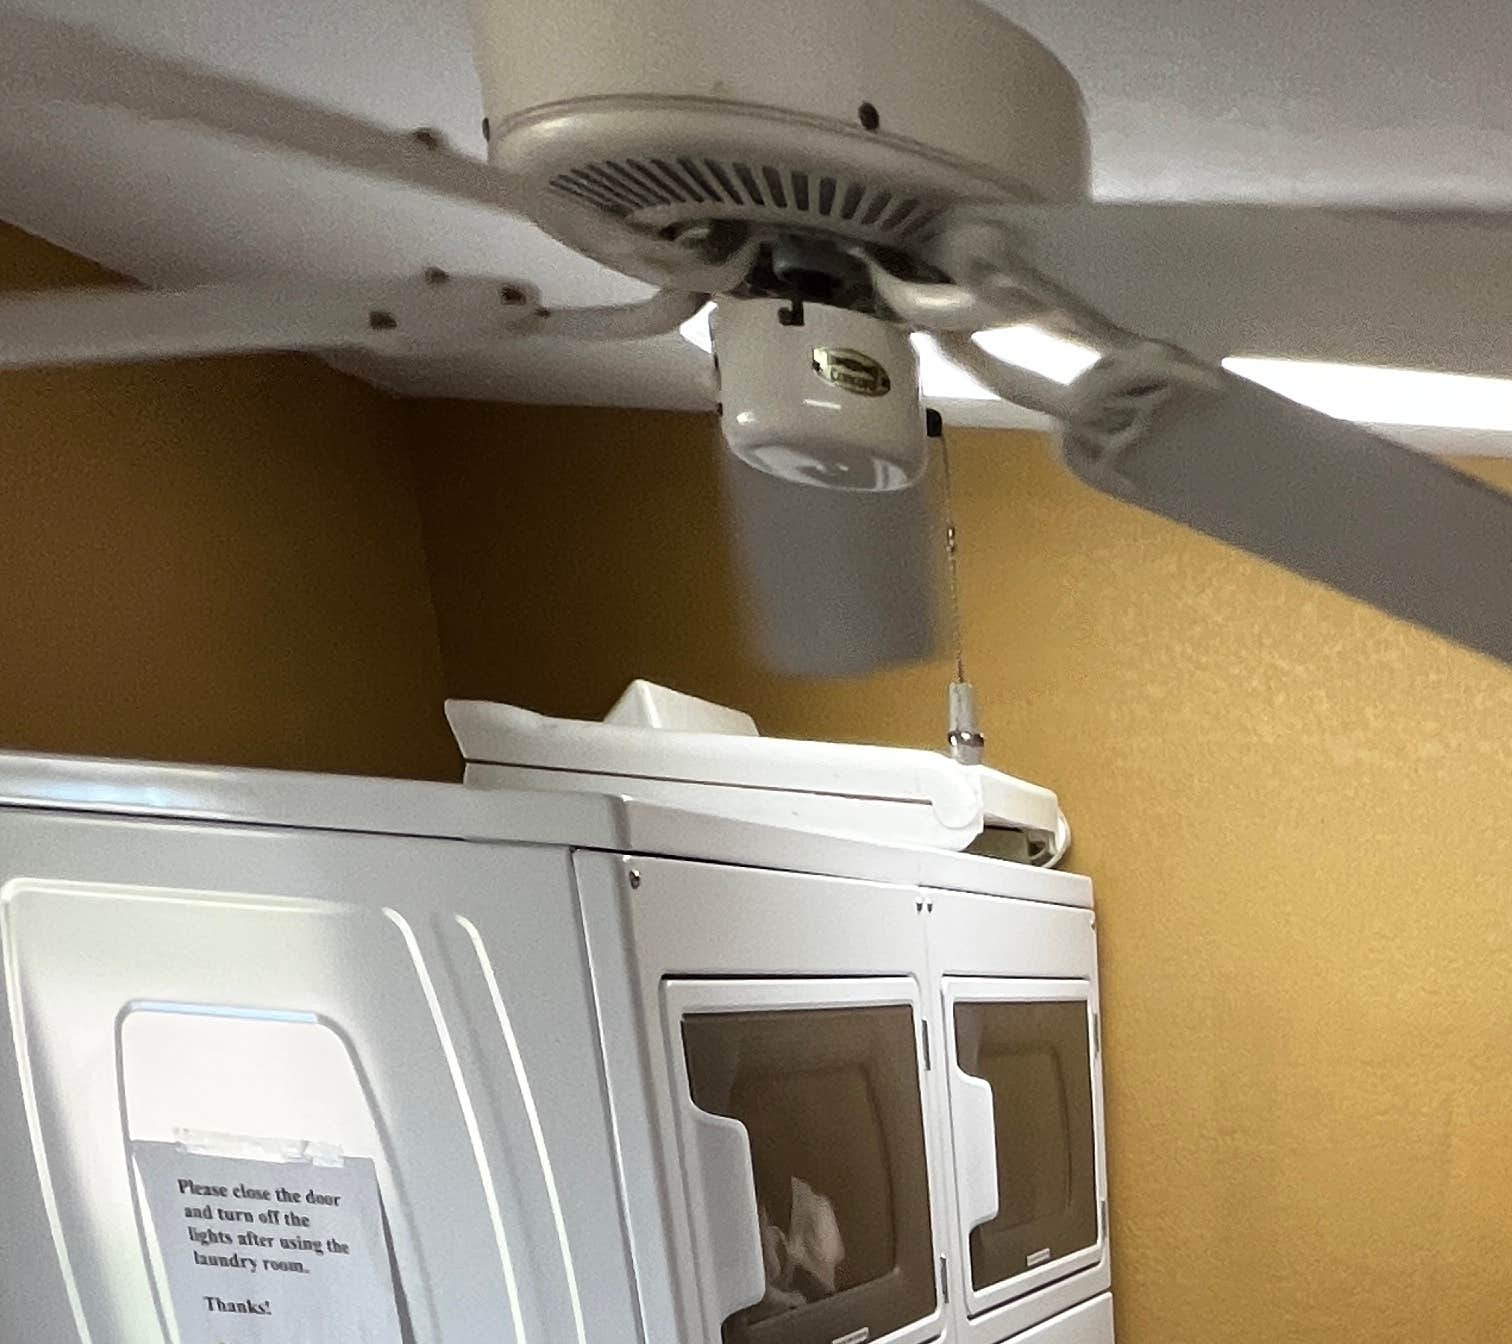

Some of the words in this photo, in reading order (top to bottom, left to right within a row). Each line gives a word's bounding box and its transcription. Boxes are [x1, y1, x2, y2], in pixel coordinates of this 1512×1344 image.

[177, 1179, 228, 1197] Please
[232, 1183, 271, 1201] close
[274, 1187, 301, 1203] the
[305, 1189, 341, 1207] door
[184, 1205, 213, 1220] and
[217, 1208, 254, 1223] turn
[258, 1209, 280, 1225] off
[284, 1211, 310, 1227] the
[187, 1226, 233, 1246] lights
[237, 1231, 274, 1248] after
[279, 1236, 324, 1256] using
[327, 1238, 350, 1254] the
[193, 1250, 257, 1273] laundry
[262, 1258, 310, 1274] room.
[203, 1296, 272, 1315] Thanks!
